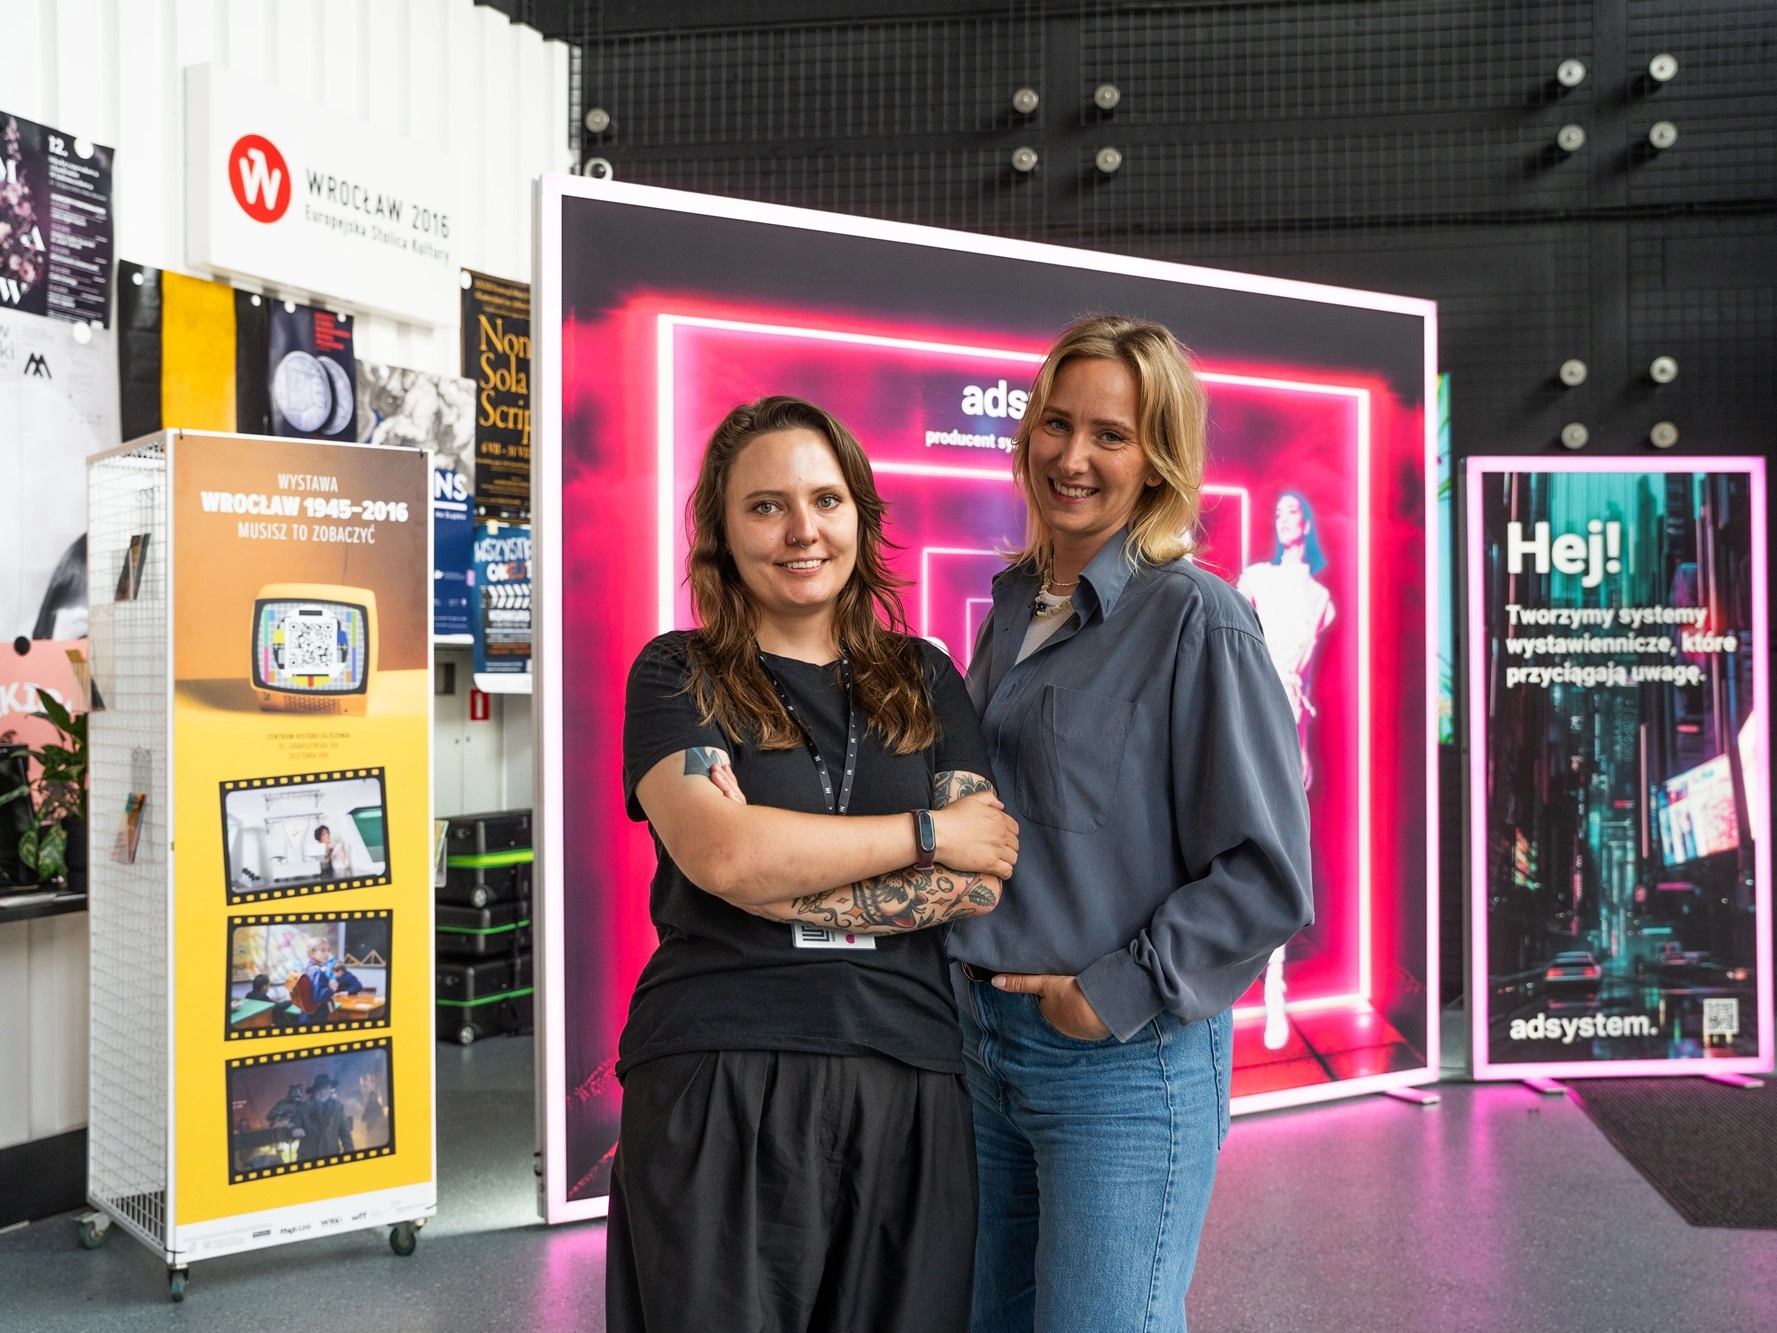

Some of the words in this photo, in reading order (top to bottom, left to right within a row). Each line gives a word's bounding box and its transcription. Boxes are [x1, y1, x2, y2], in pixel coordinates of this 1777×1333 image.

[48, 134, 69, 158] 12.
[306, 168, 402, 222] WROCŁAW
[412, 204, 450, 239] 2016
[477, 313, 530, 359] Non
[478, 351, 528, 394] Sola
[961, 379, 1032, 420] ads
[925, 428, 996, 449] producent
[997, 436, 1018, 453] sy
[277, 473, 338, 492] WYSTAWA
[200, 490, 301, 516] WROCŁAW
[302, 496, 409, 522] 1945–2016
[237, 521, 288, 540] MUSISZ
[292, 523, 308, 541] TO
[312, 524, 376, 544] ZOBACZYĆ
[1507, 519, 1622, 588] Hej!
[1505, 604, 1615, 630] Tworzymy
[1618, 604, 1708, 629] systemy
[1506, 632, 1678, 659] wystawiennicze,
[1681, 630, 1738, 654] które
[1506, 660, 1629, 688] przyciągają
[1630, 664, 1708, 687] uwagę.
[1509, 1012, 1659, 1044] adsystem.
